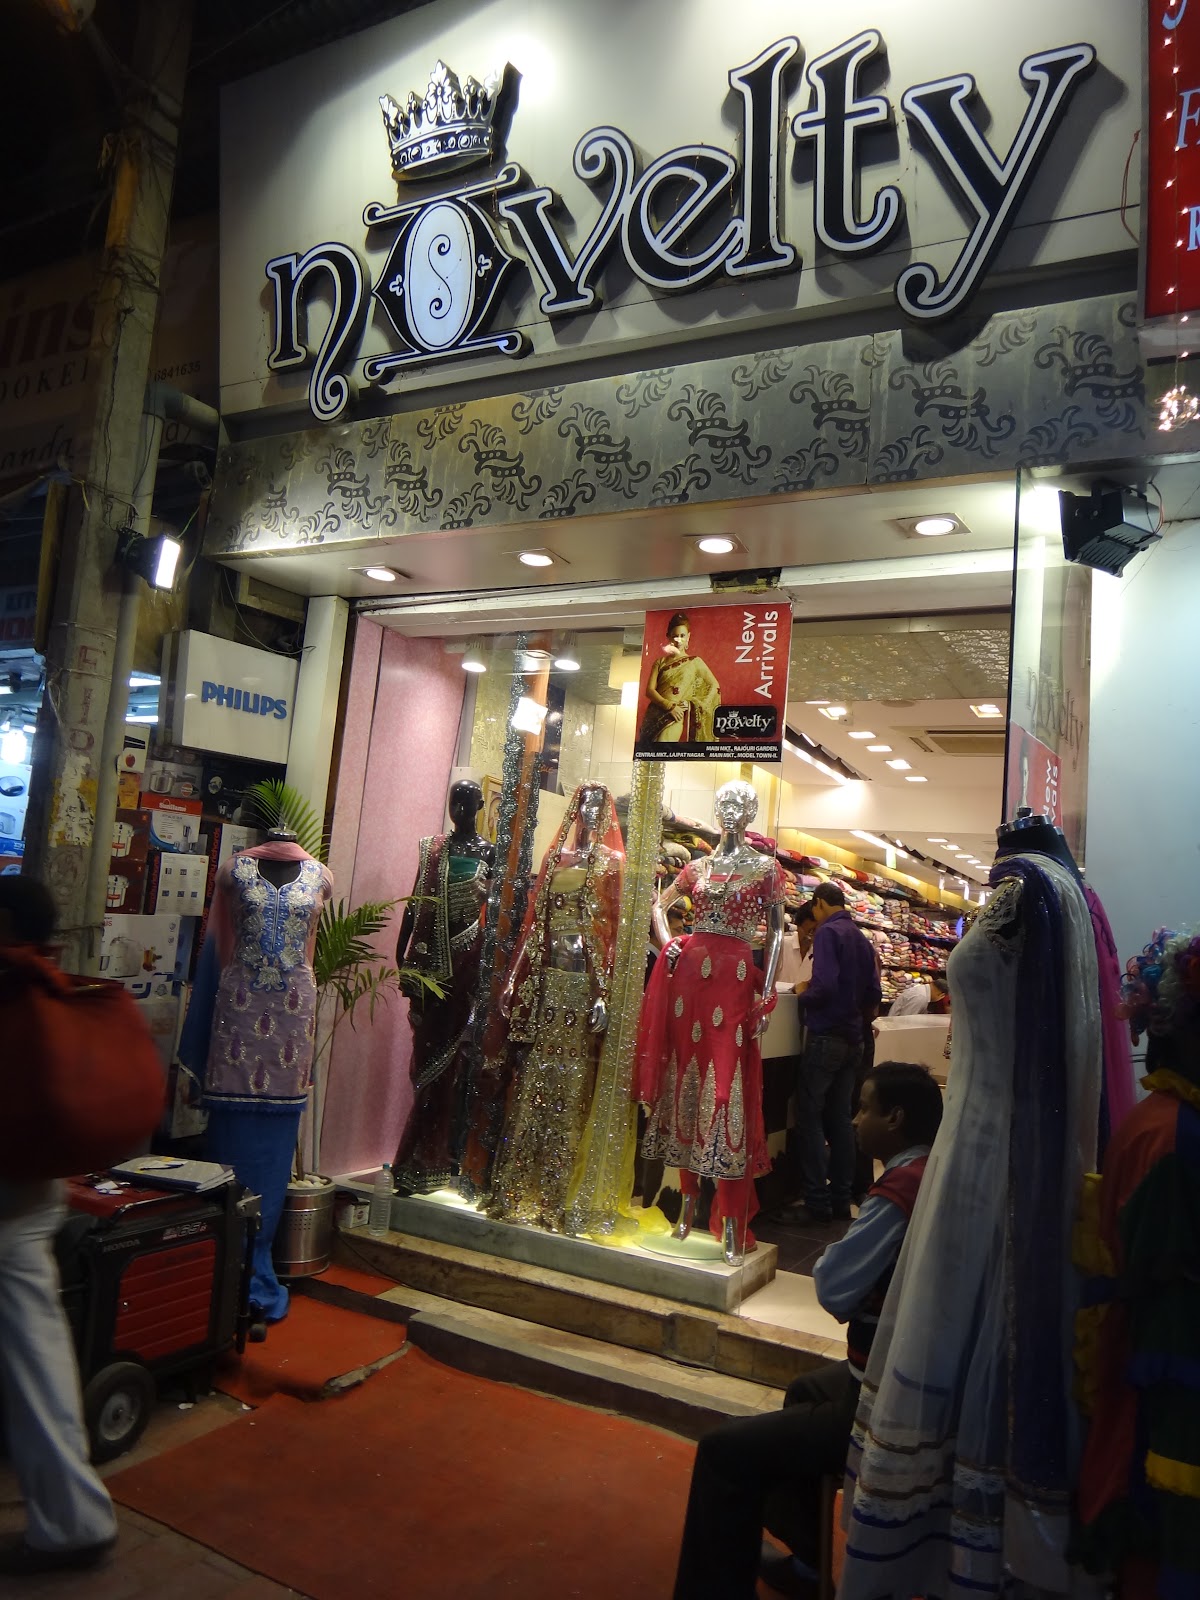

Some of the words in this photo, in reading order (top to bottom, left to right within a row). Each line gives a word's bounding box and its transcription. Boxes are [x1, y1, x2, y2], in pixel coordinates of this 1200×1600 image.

[735, 611, 756, 663] New
[753, 610, 779, 699] Arrivals
[201, 681, 287, 720] PHILIPS
[715, 713, 772, 733] novelty
